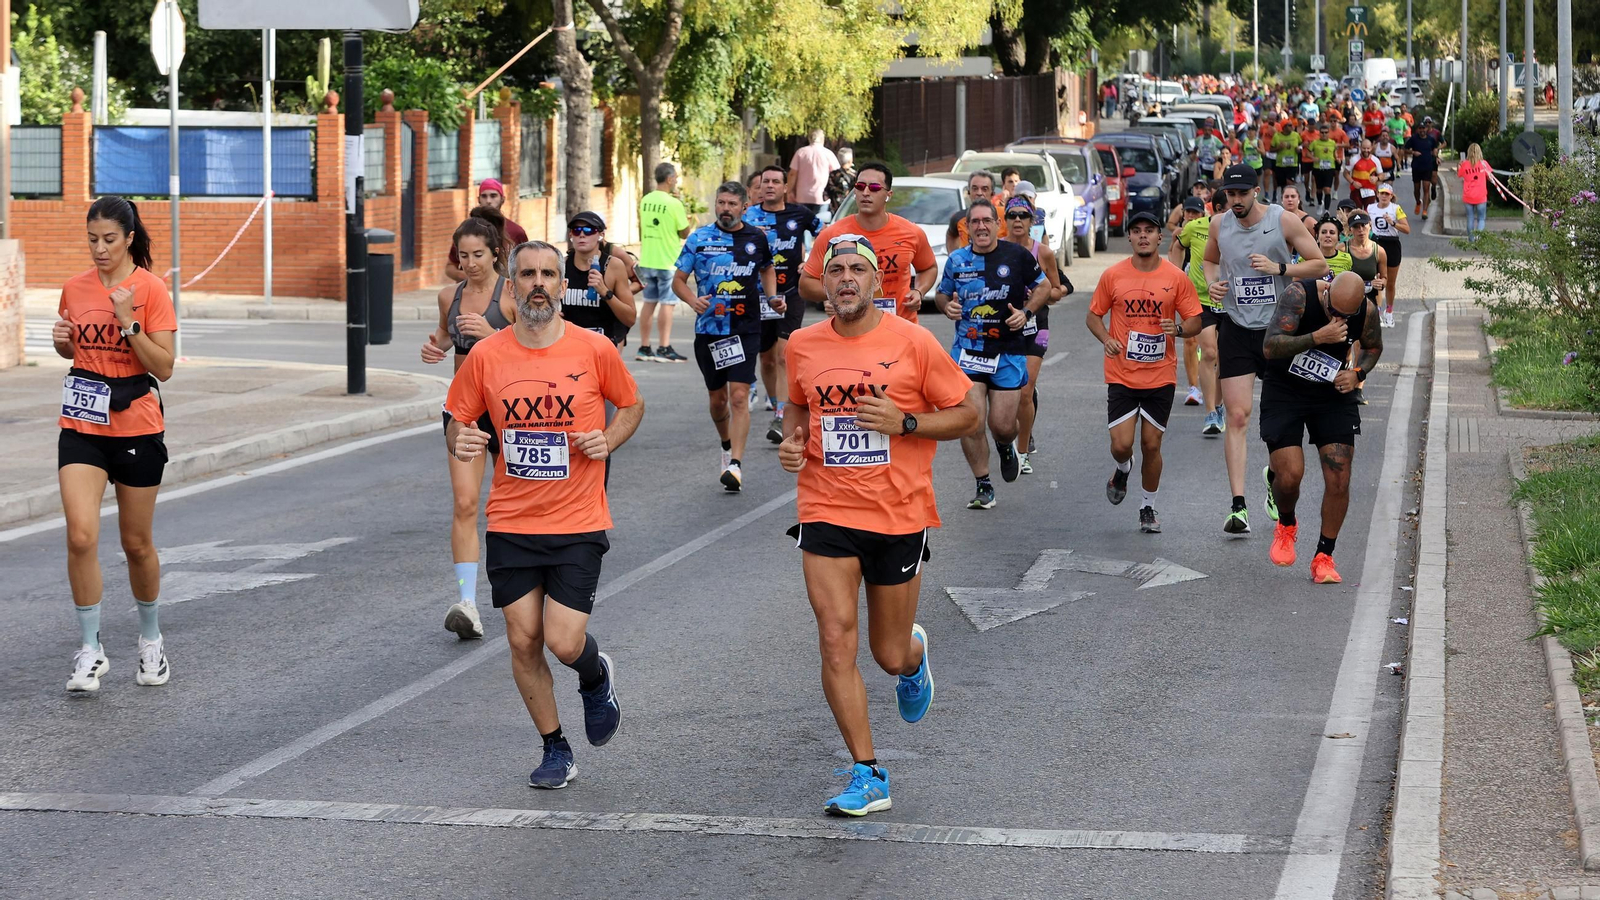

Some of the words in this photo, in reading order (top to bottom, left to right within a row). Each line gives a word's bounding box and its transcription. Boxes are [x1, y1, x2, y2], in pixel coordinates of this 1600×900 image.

[1196, 232, 1209, 241] Pap
[1244, 286, 1265, 296] 865
[1124, 299, 1163, 314] XXIX
[718, 347, 734, 359] 631
[1137, 343, 1158, 353] 909
[1301, 357, 1330, 377] 1013
[72, 392, 97, 408] 757
[502, 395, 575, 421] XXIX
[837, 433, 869, 450] 701
[517, 447, 551, 464] 785
